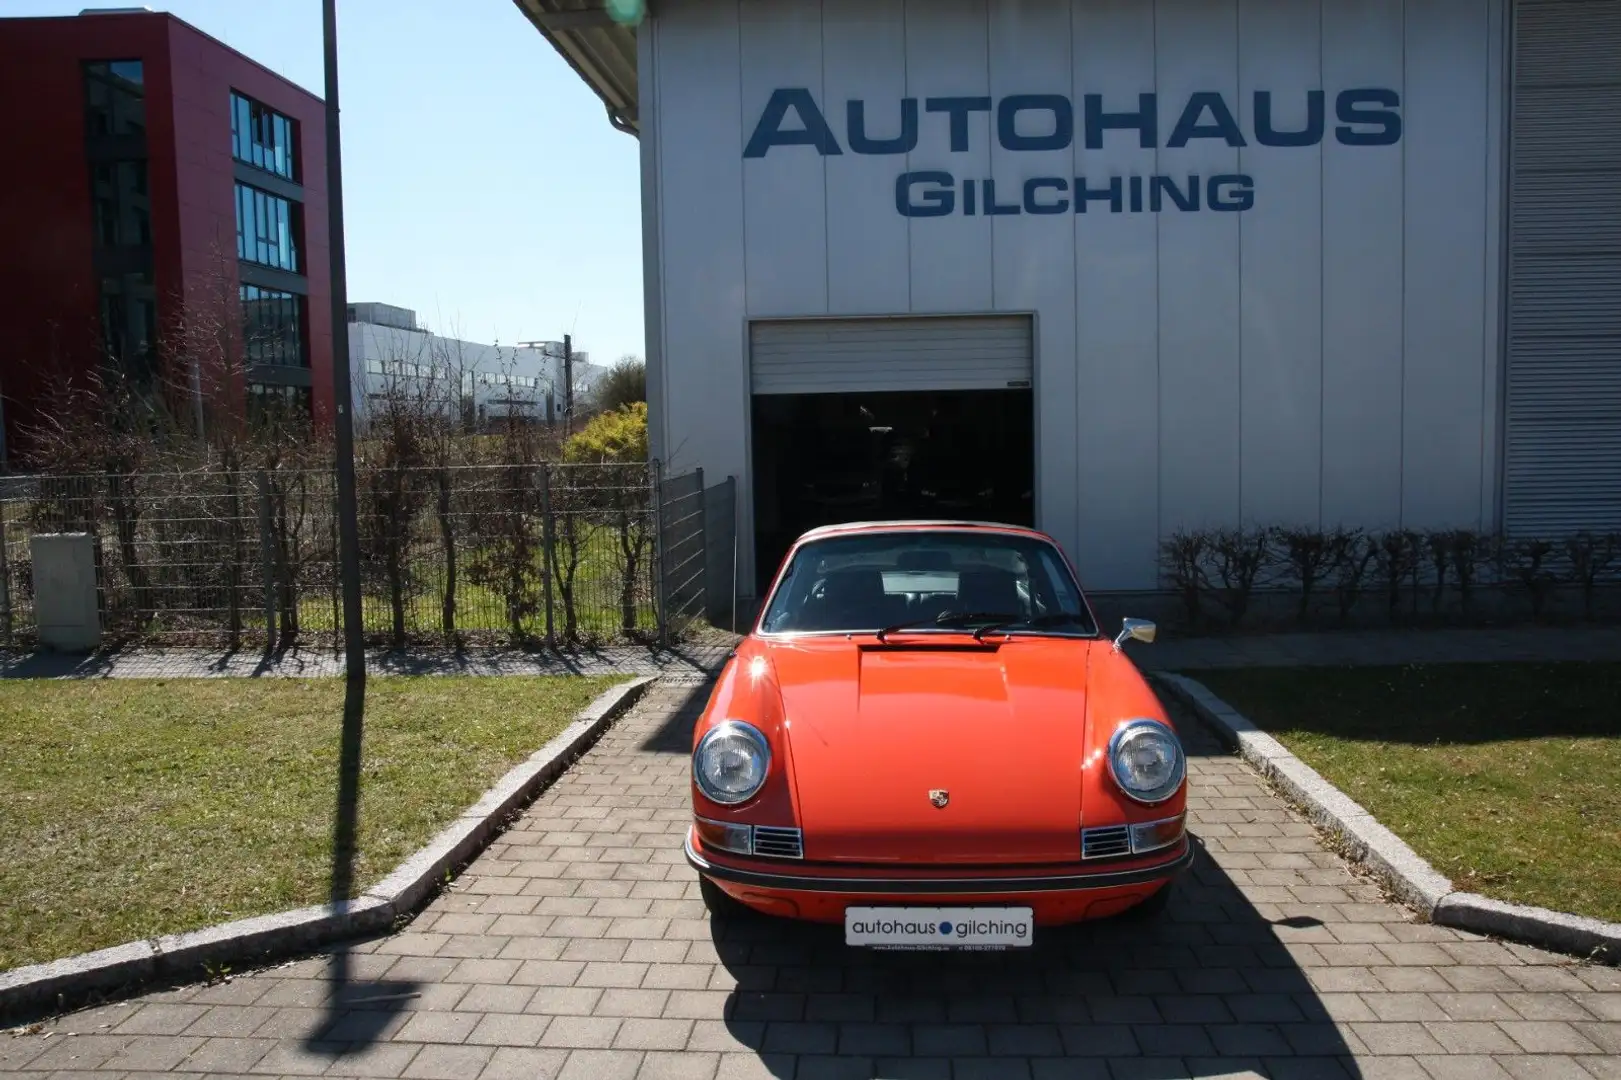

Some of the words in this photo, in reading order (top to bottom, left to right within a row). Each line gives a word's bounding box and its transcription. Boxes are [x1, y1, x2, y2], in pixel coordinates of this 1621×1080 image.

[742, 87, 1403, 158] AUTOHAUS
[895, 171, 1254, 218] GILCHING
[852, 919, 936, 935] autohaus
[955, 919, 1027, 939] gilching
